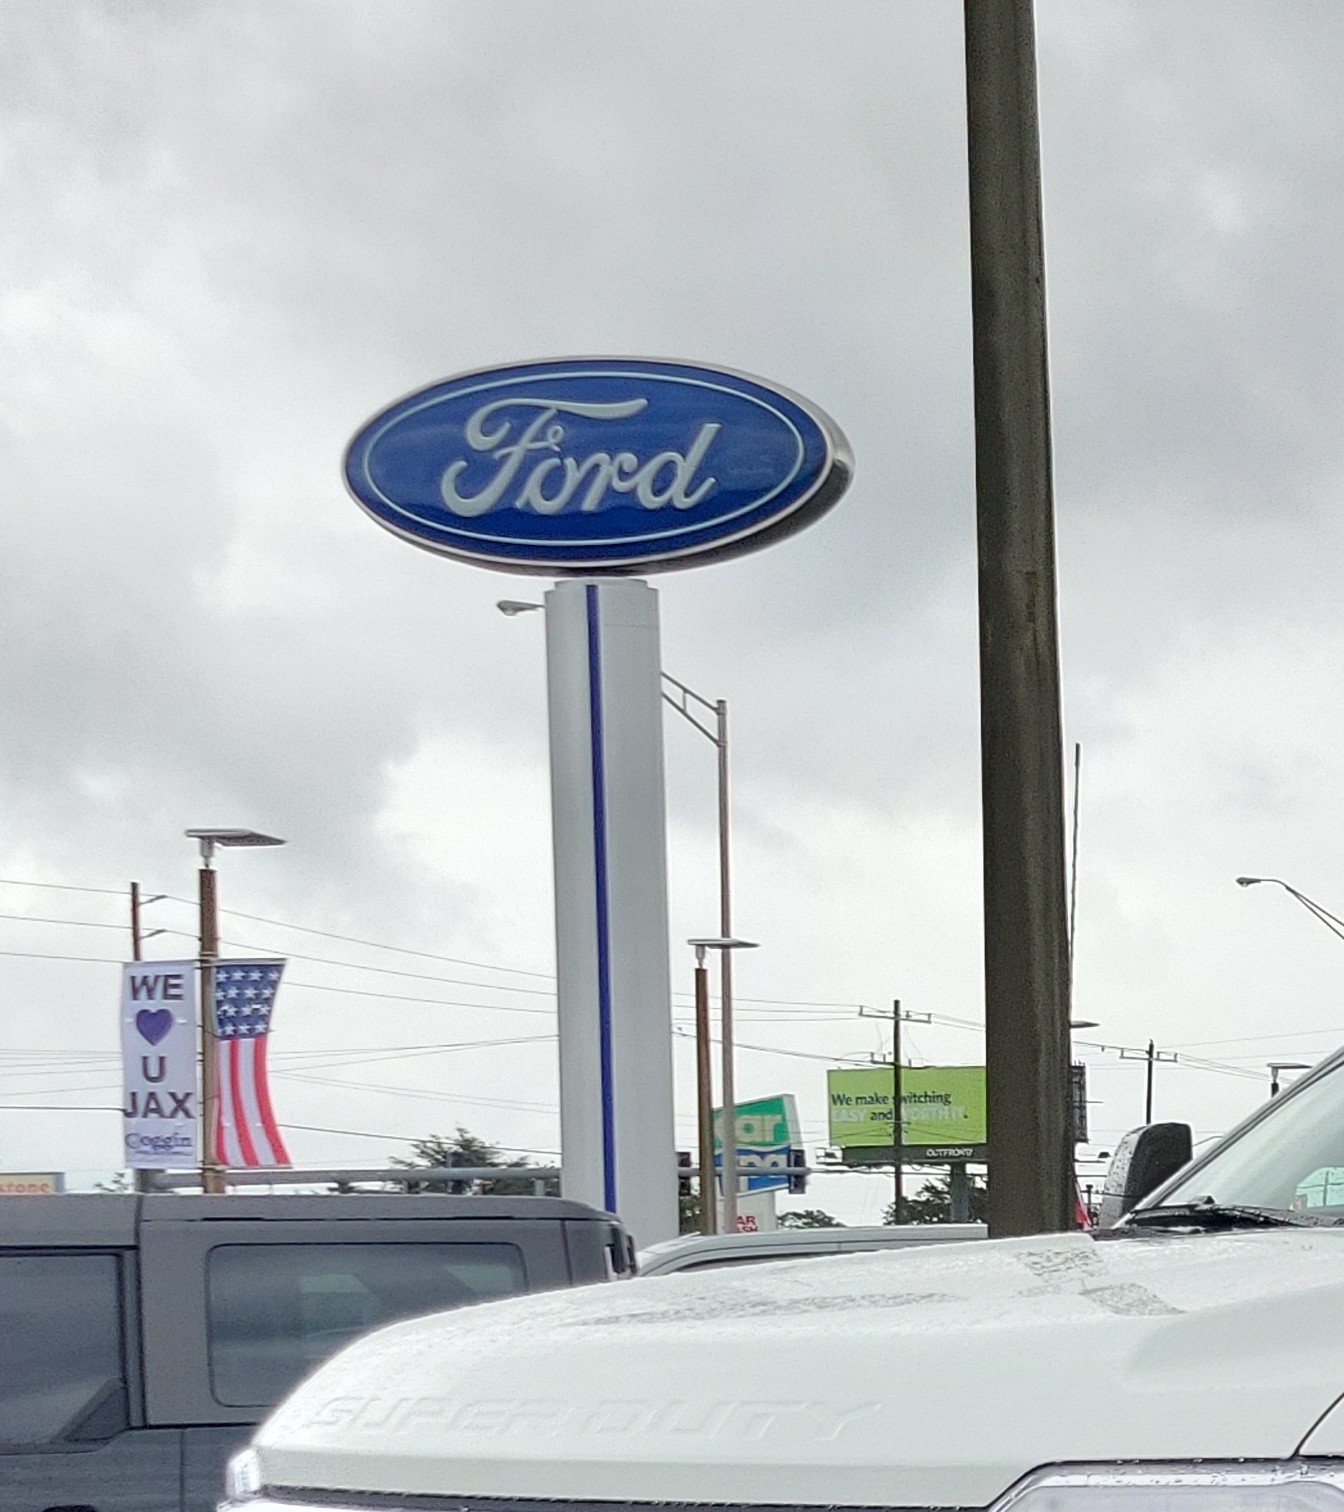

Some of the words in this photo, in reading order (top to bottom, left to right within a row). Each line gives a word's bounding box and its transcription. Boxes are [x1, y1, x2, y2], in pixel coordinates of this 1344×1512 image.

[440, 397, 722, 517] Ford
[130, 974, 184, 1000] WE
[141, 1056, 167, 1083] U
[123, 1091, 195, 1119] JAX
[831, 1093, 852, 1106] We
[855, 1091, 889, 1106] make
[893, 1090, 952, 1106] witching
[870, 1108, 893, 1121] and
[124, 1132, 193, 1151] Coggin
[305, 1395, 577, 1435] SUPER
[580, 1397, 885, 1442] DUTY
